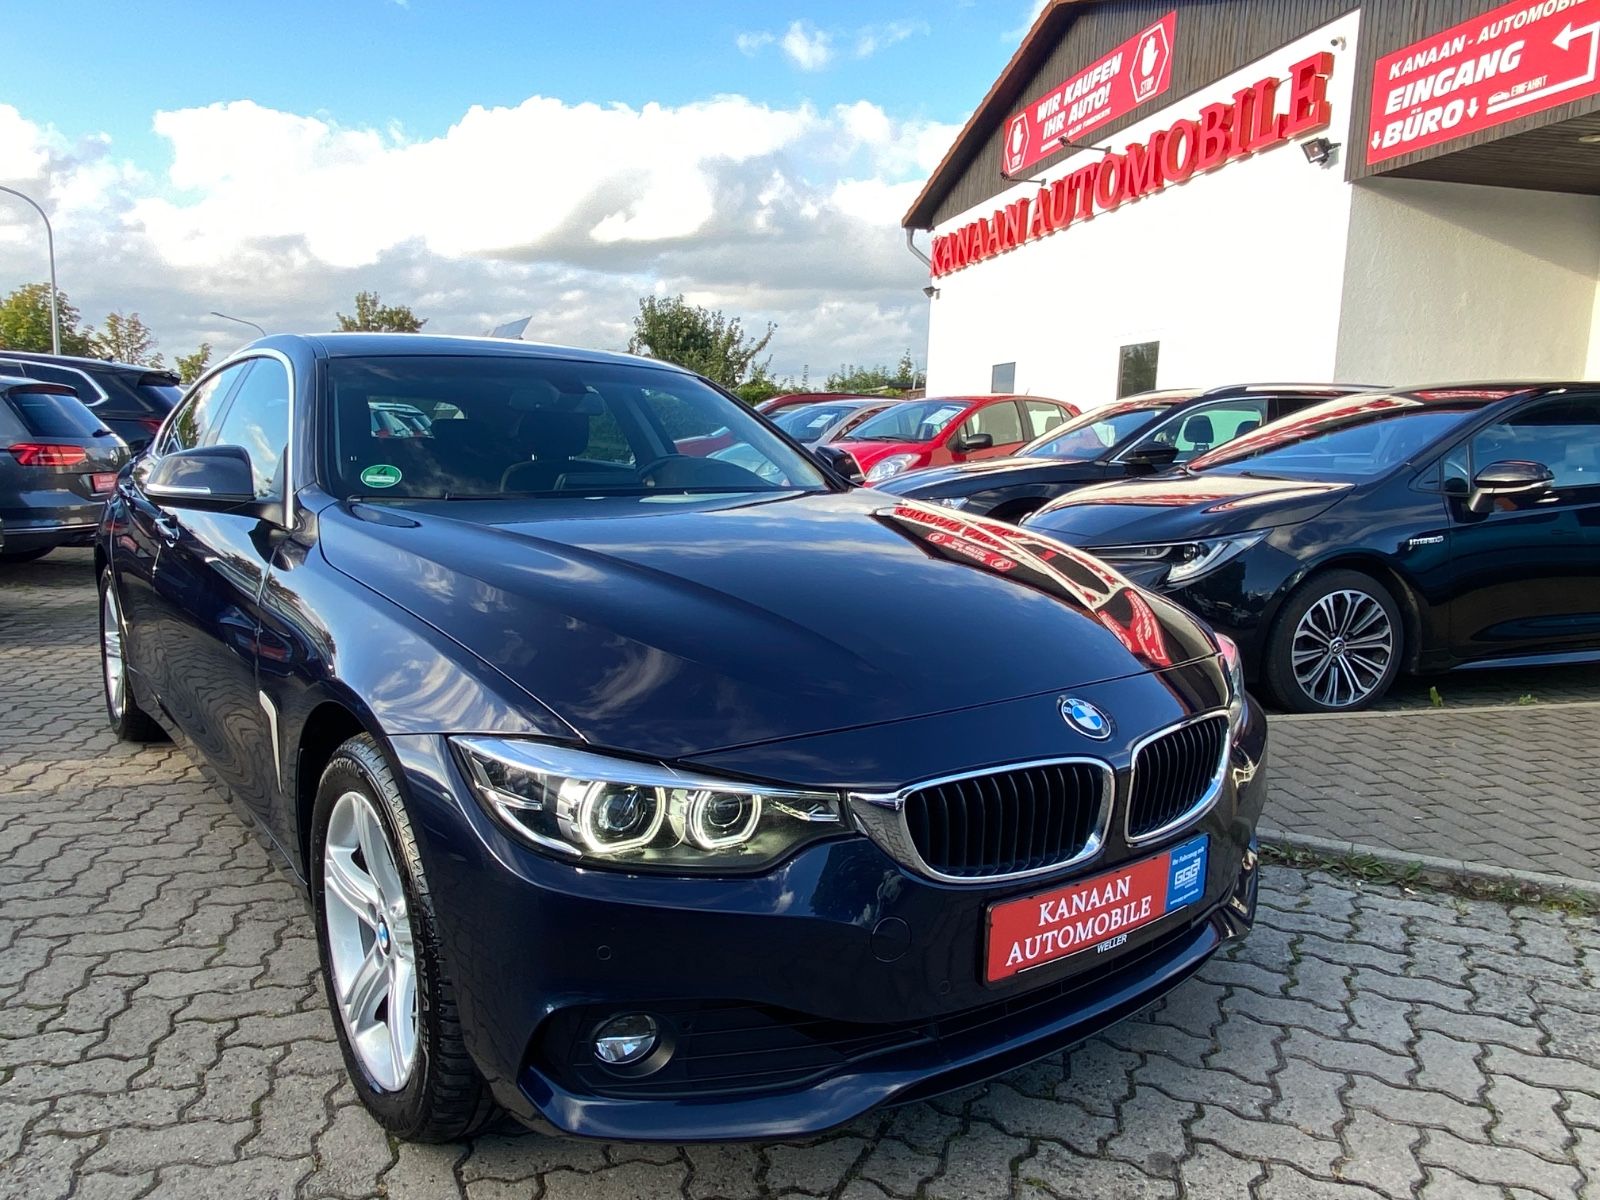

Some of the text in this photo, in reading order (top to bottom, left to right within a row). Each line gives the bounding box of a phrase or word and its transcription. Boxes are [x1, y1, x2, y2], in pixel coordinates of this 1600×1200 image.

[1384, 40, 1525, 115] EINGANG
[1389, 34, 1466, 79] KANAAN
[1036, 92, 1062, 124] WIR
[1063, 52, 1124, 107] KAUFEN
[1042, 110, 1066, 141] IHR
[1067, 82, 1112, 126] AUTO!
[1381, 98, 1465, 149] BÜRO
[930, 51, 1332, 278] KANAAN AUTOMOBILE
[1005, 894, 1153, 967] AUTOMOBILE
[1038, 875, 1132, 927] KANAAN
[1096, 934, 1127, 955] WELLER
